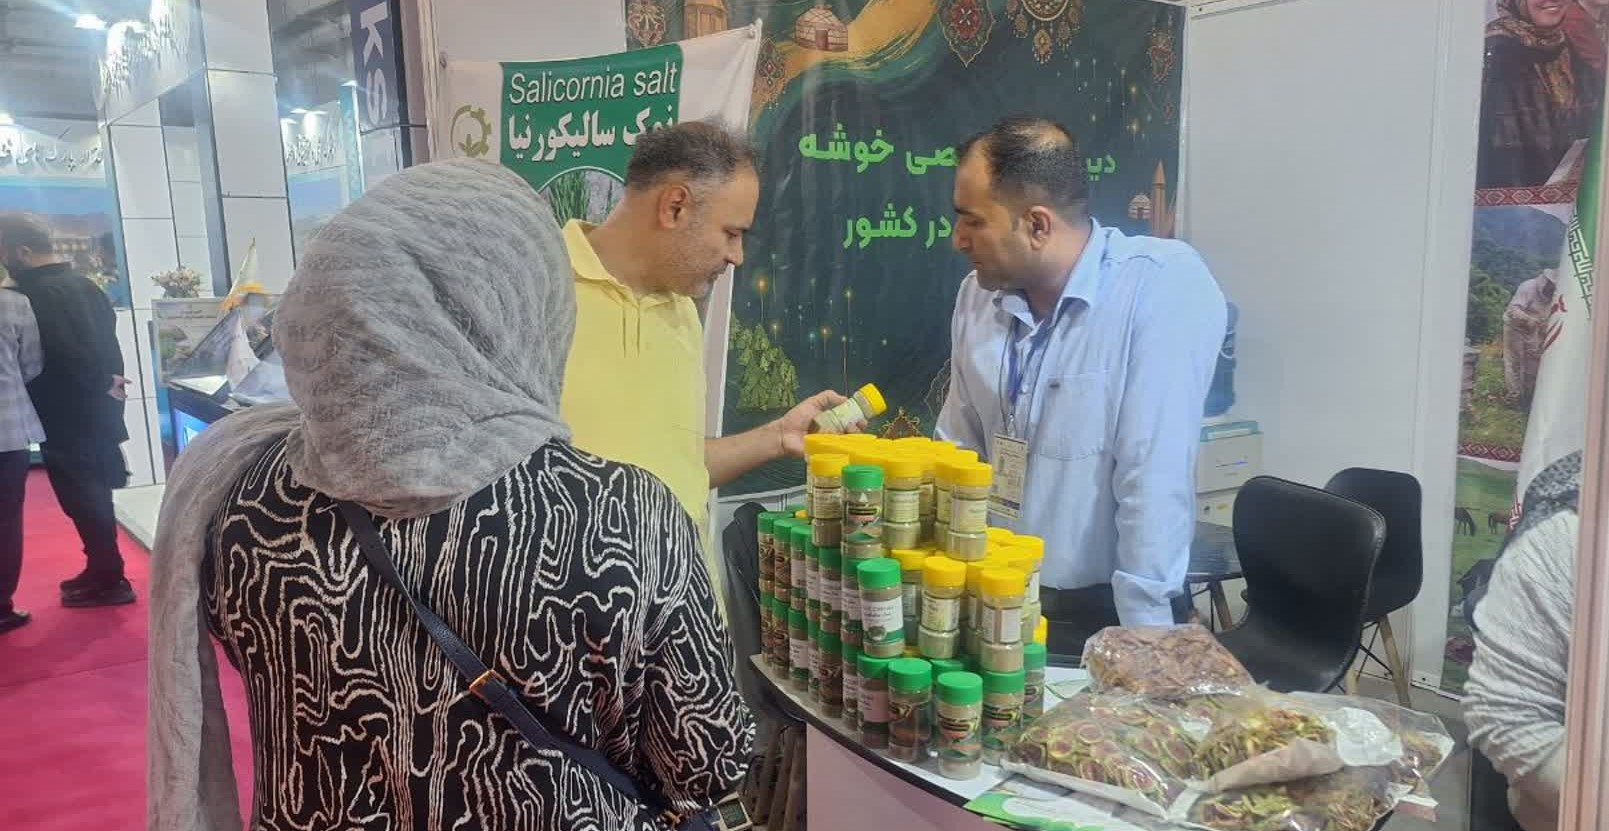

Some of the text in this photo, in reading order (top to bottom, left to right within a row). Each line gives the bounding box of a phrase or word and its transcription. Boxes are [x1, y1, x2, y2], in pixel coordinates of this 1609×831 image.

[509, 60, 677, 104] Salicornia salt
[508, 109, 615, 161] سالیکورنیا
[799, 122, 895, 173] خوشه
[843, 203, 953, 249] در کشور
